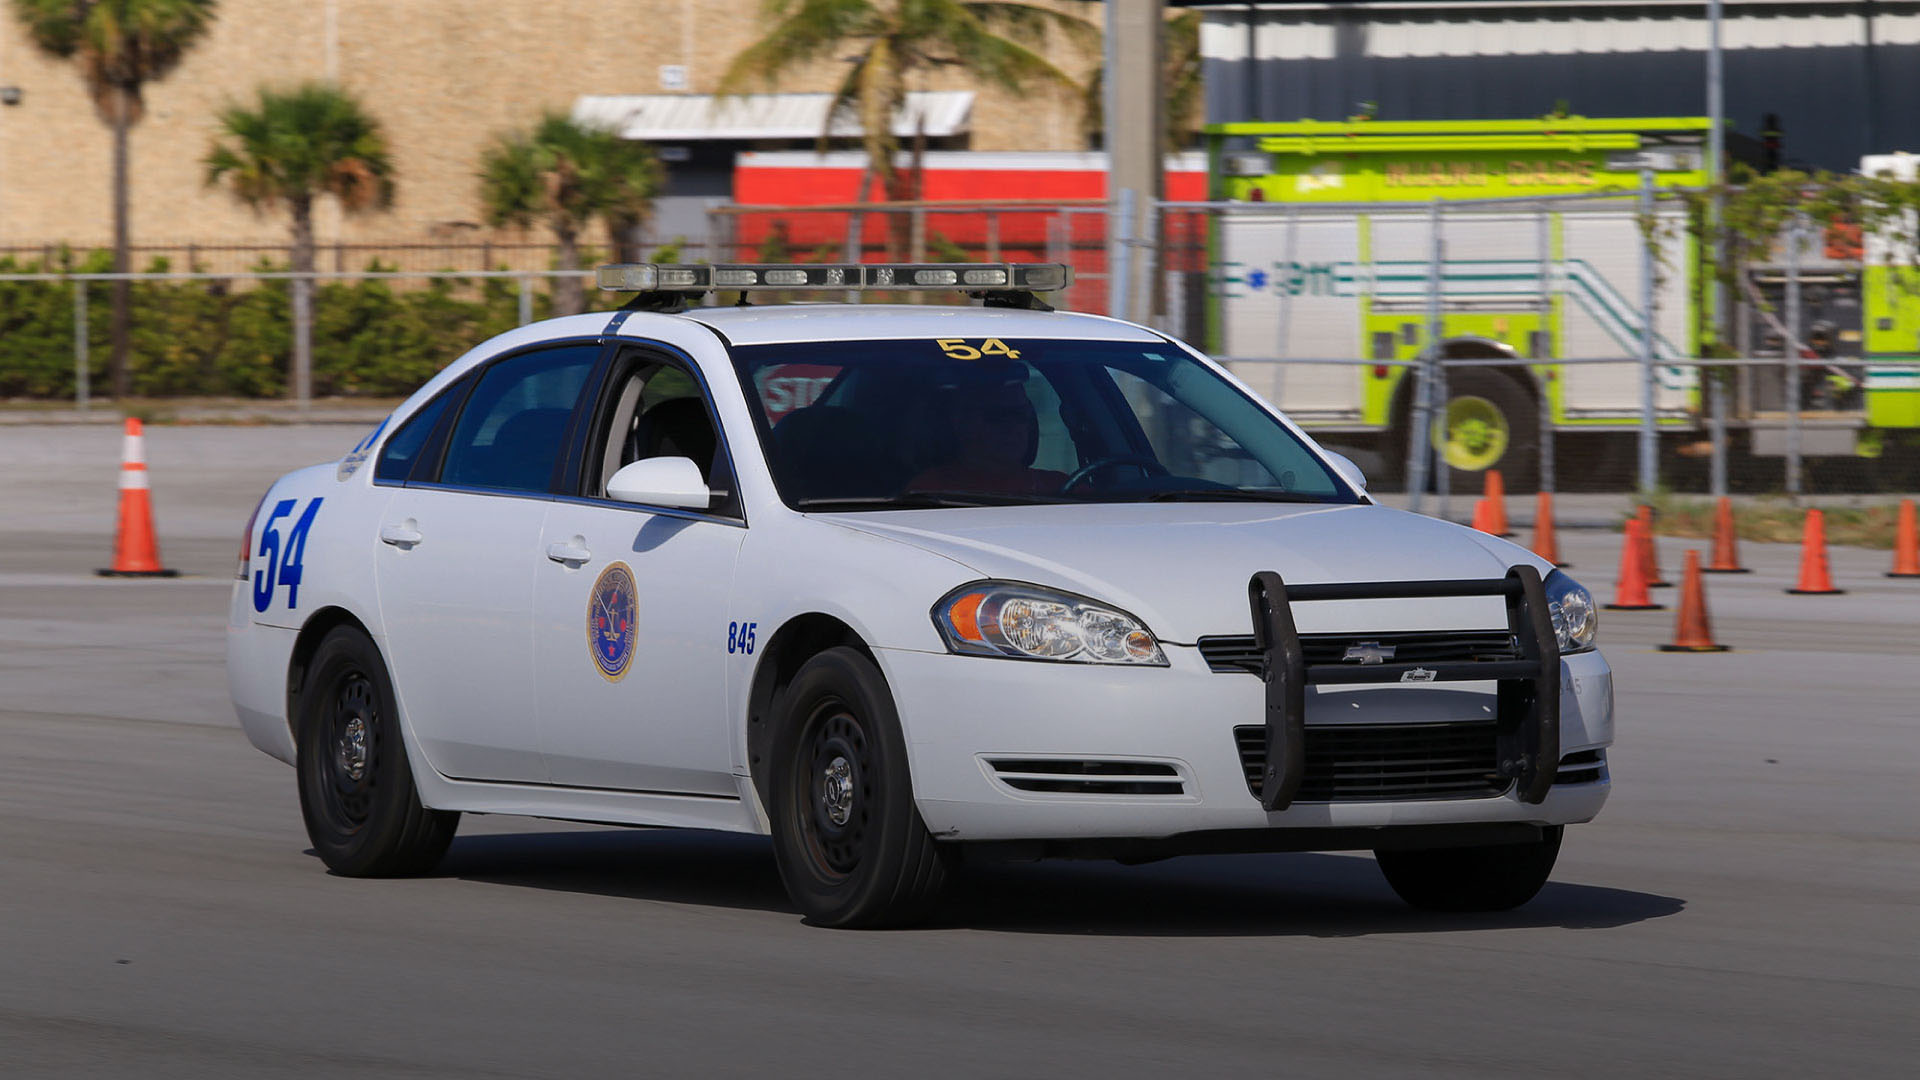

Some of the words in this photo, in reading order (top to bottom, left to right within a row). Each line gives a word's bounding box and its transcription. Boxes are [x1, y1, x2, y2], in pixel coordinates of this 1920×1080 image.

[936, 338, 1020, 360] 54
[253, 497, 324, 613] 54
[728, 621, 757, 655] 845
